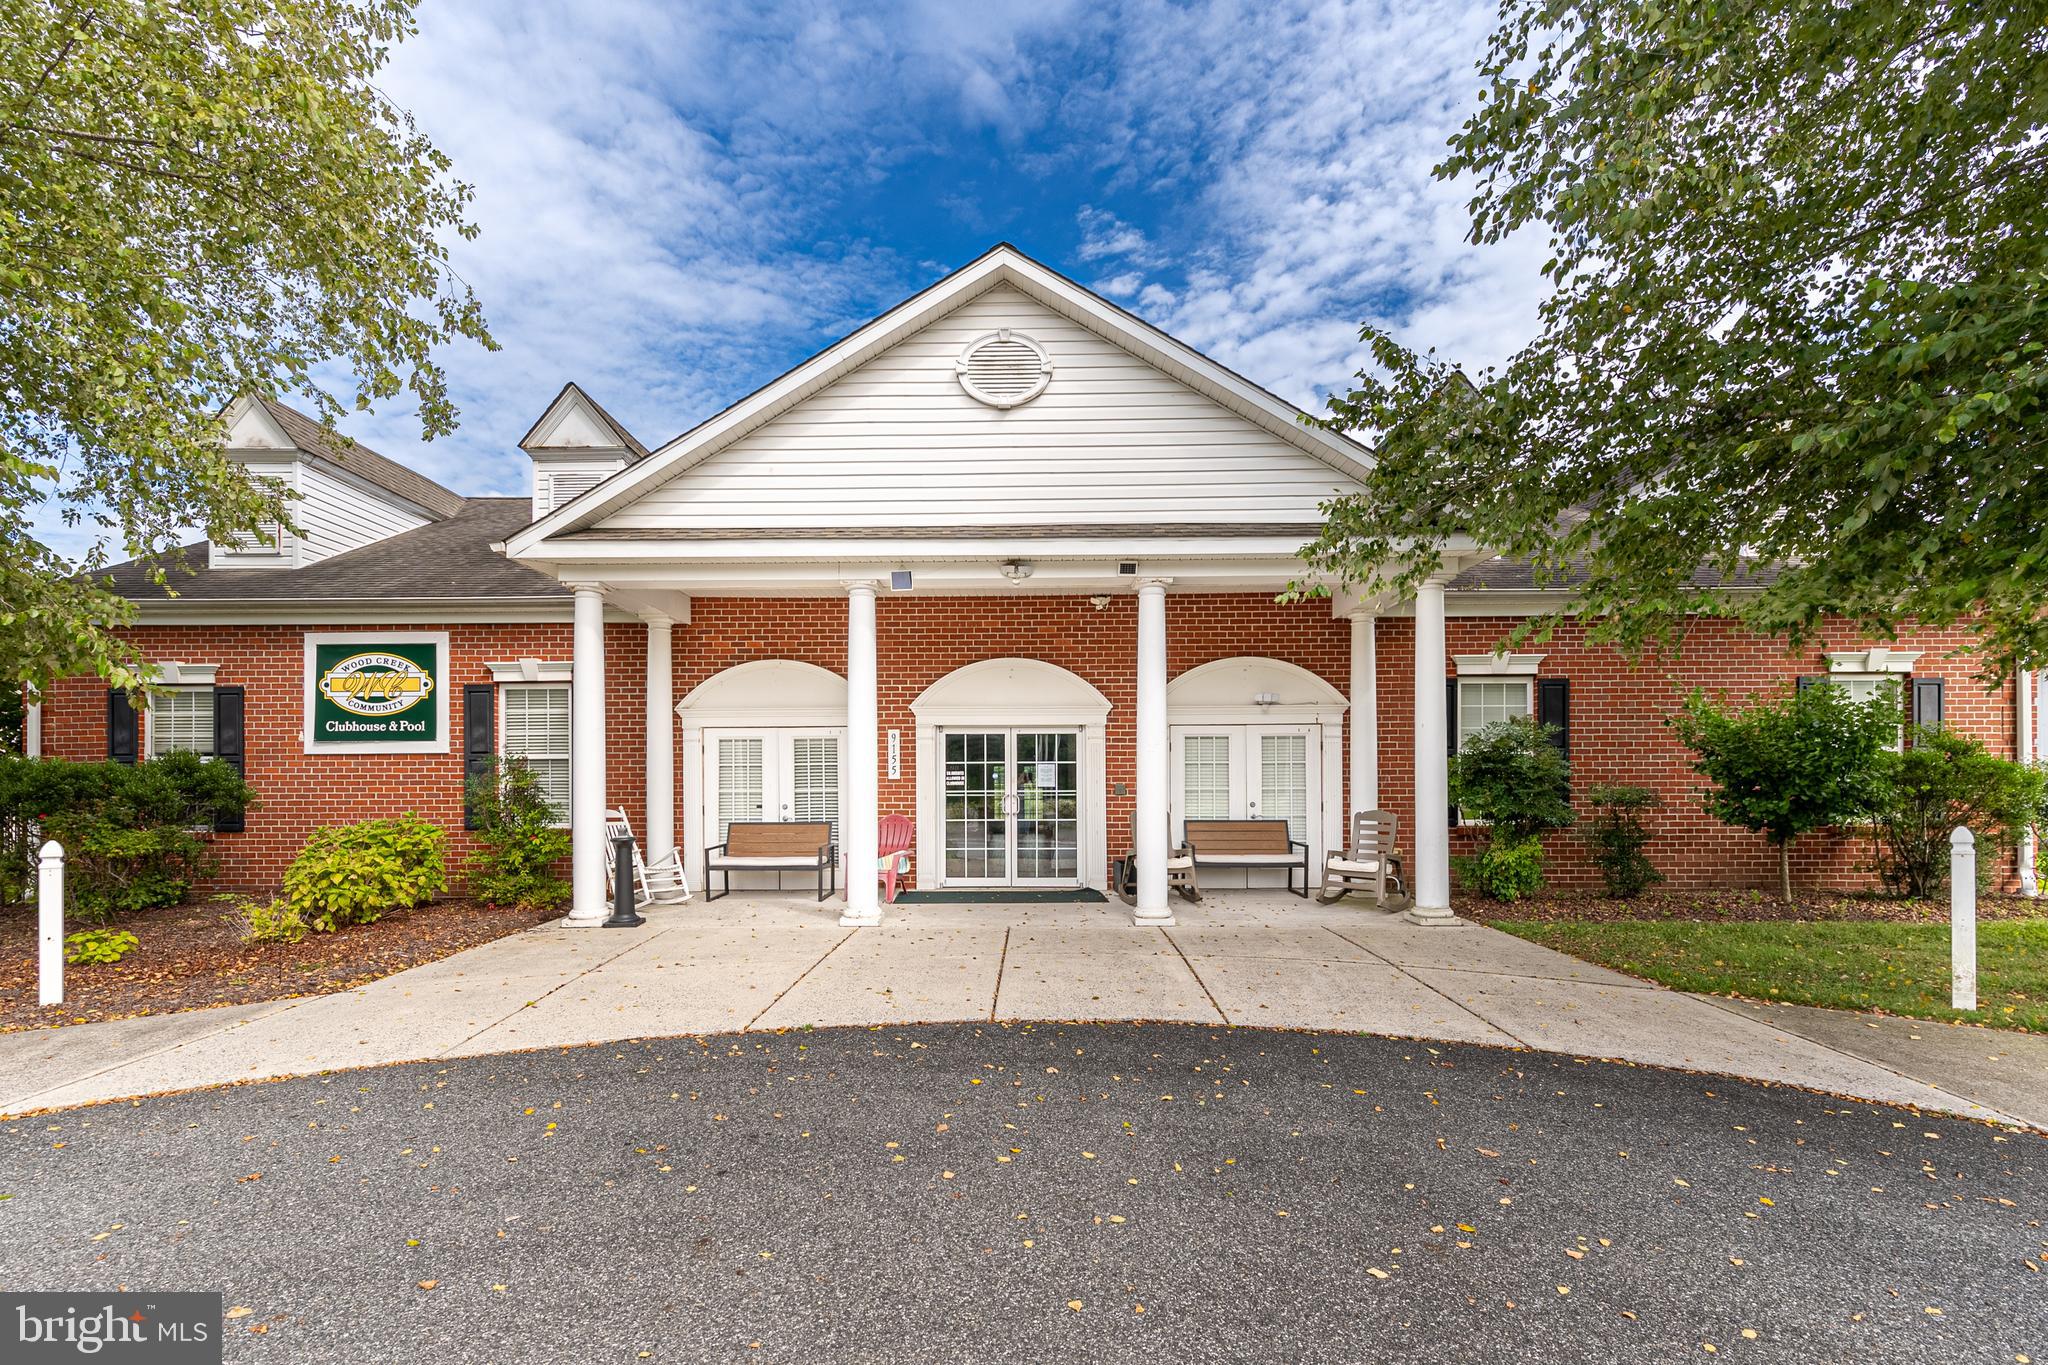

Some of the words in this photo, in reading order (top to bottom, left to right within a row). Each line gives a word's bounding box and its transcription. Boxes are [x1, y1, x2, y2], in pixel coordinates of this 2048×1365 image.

[341, 657, 373, 673] WOOD
[376, 657, 411, 673] CREEK
[347, 699, 404, 712] COMMUNITY
[325, 720, 387, 732] Clubhouse
[388, 720, 399, 732] &
[399, 720, 426, 732] Pool
